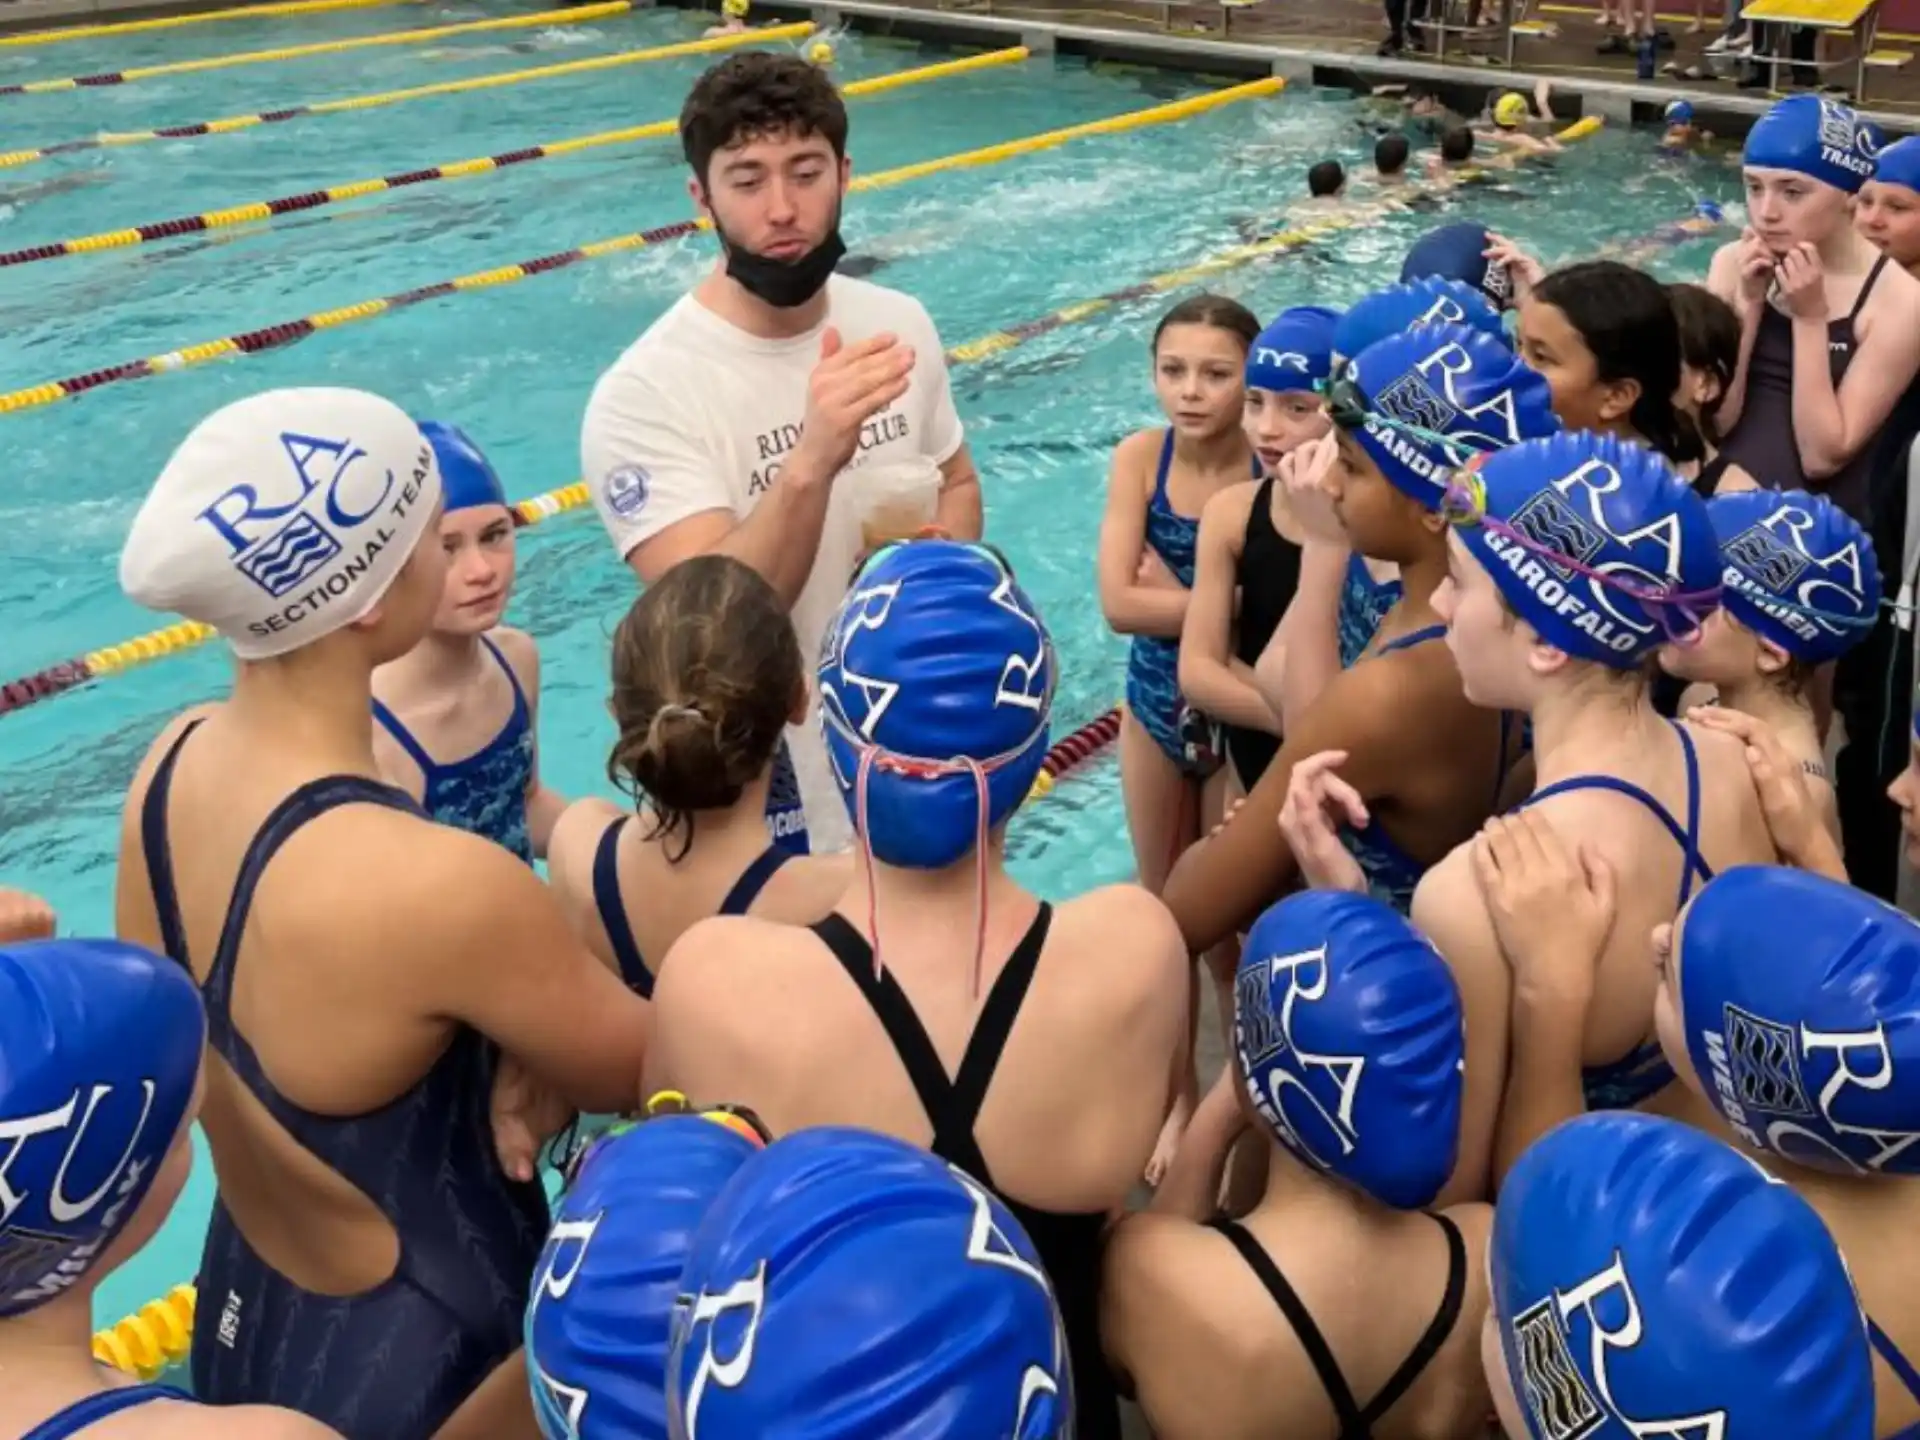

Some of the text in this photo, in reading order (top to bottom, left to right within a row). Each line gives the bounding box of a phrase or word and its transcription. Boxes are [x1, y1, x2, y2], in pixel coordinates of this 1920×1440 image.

[1257, 347, 1310, 373] TYR
[195, 431, 395, 559] RAC
[756, 421, 803, 460] RID
[247, 443, 432, 639] SECTIONAL TEAM
[1482, 529, 1638, 653] GAROFALO
[1550, 456, 1682, 634] RAC
[1763, 505, 1866, 637] RAC
[1268, 940, 1365, 1169] RAC
